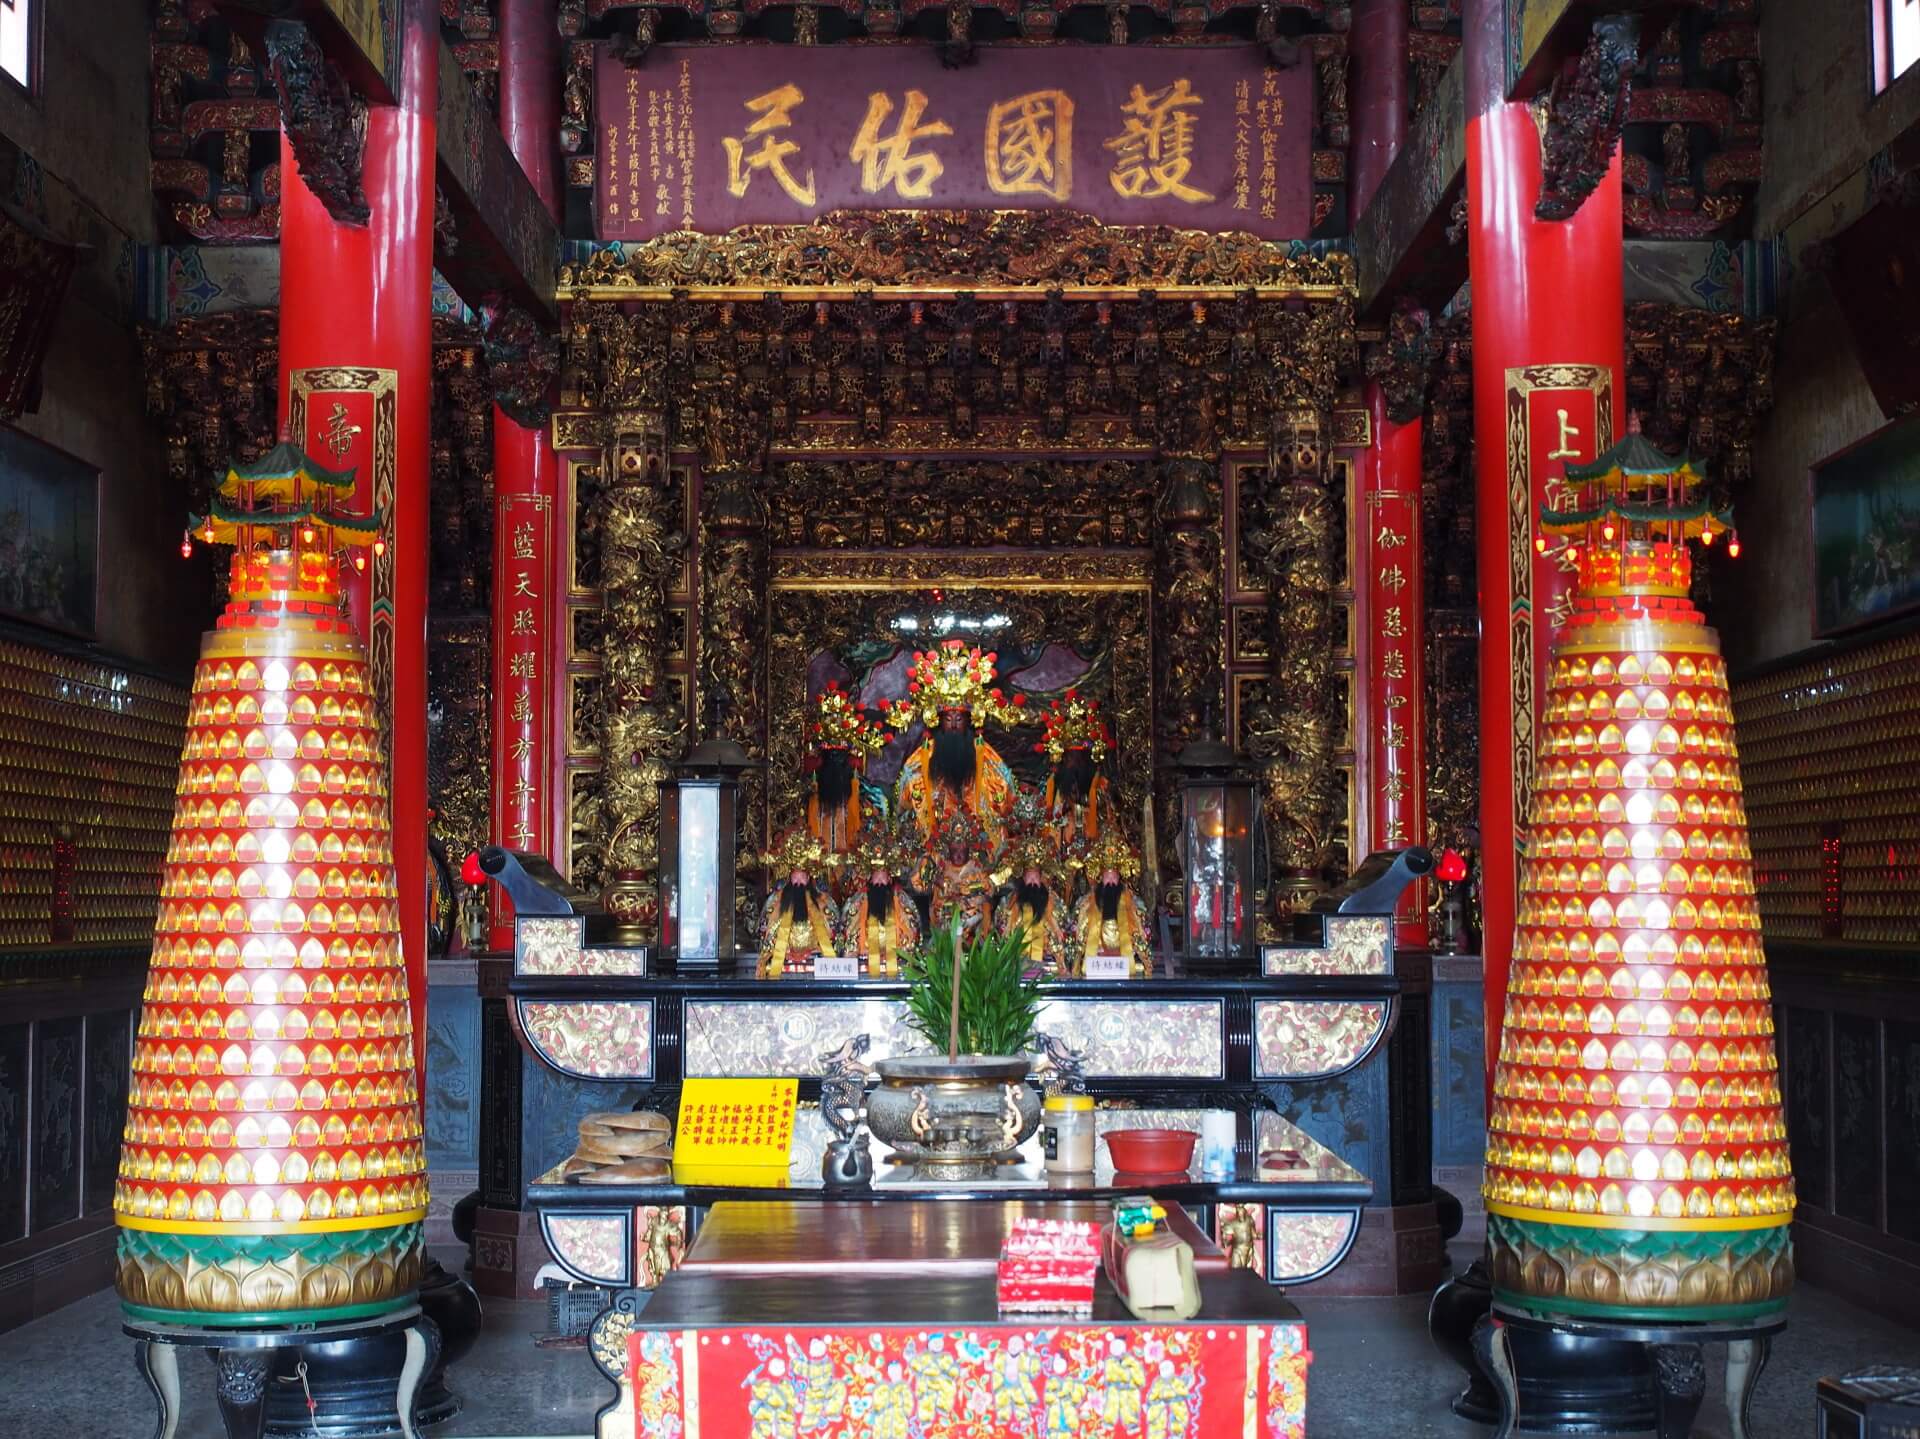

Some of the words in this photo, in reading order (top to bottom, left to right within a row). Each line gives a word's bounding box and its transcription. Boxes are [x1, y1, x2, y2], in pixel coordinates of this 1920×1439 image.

[624, 69, 643, 222] 次辛未年葭月吉旦
[508, 521, 538, 848] 藍天照耀萬方赤子
[1377, 526, 1409, 843] 伽佛慈悲四海蒼生
